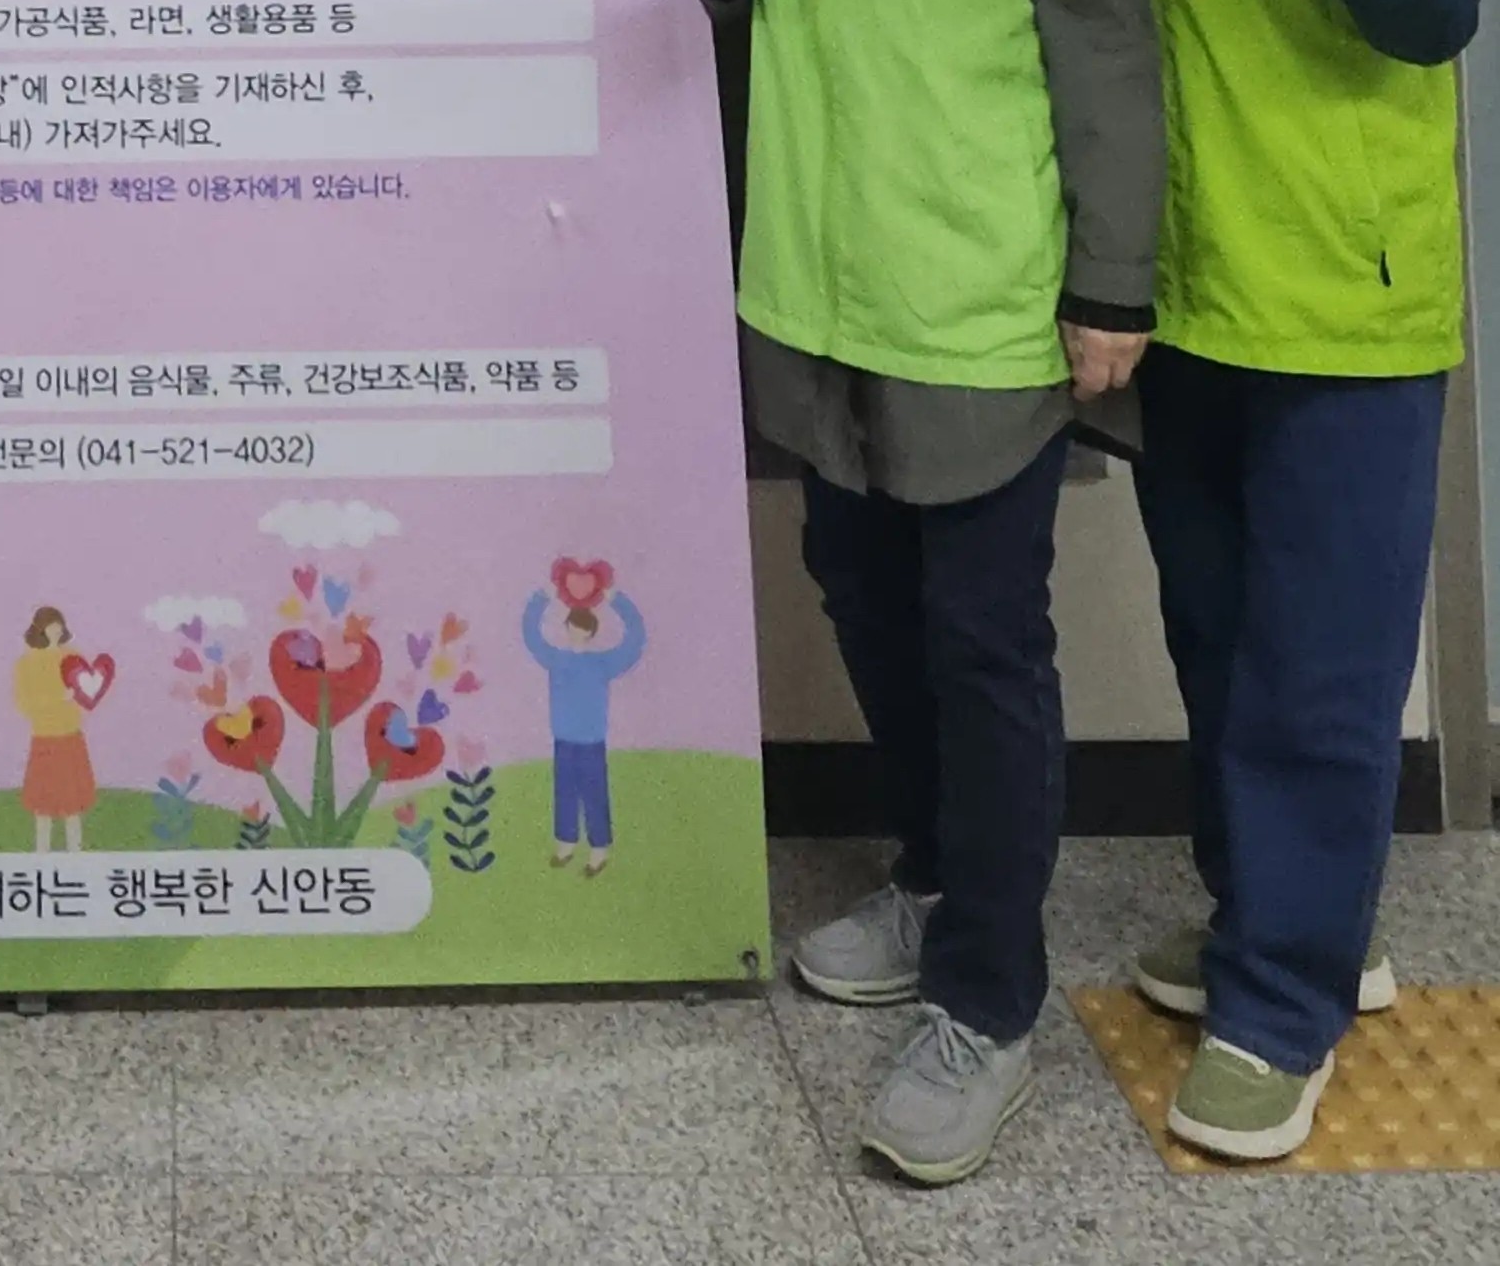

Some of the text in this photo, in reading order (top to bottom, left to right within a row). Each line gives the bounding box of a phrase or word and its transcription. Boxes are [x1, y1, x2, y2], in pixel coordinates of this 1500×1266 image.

[128, 4, 194, 36] 라면,
[206, 3, 318, 35] 생활용품
[328, 2, 357, 34] 등
[61, 70, 202, 107] 인적사항을
[213, 69, 327, 104] 기재하신
[336, 68, 375, 104] 후,
[44, 116, 223, 151] 가져가주세요.
[52, 178, 101, 205] 대한
[108, 176, 178, 205] 책임은
[186, 175, 303, 203] 이용자에게
[311, 172, 412, 202] 있습니다.
[35, 366, 120, 398] 이내의
[127, 363, 219, 397] 음식물,
[227, 363, 293, 397] 주류,
[302, 360, 477, 395] 건강보조식품,
[484, 359, 542, 392] 약품
[550, 359, 580, 392] 등
[76, 432, 316, 471] (041-521-4032)
[106, 866, 234, 918] 행복한
[250, 865, 377, 917] 신안동
